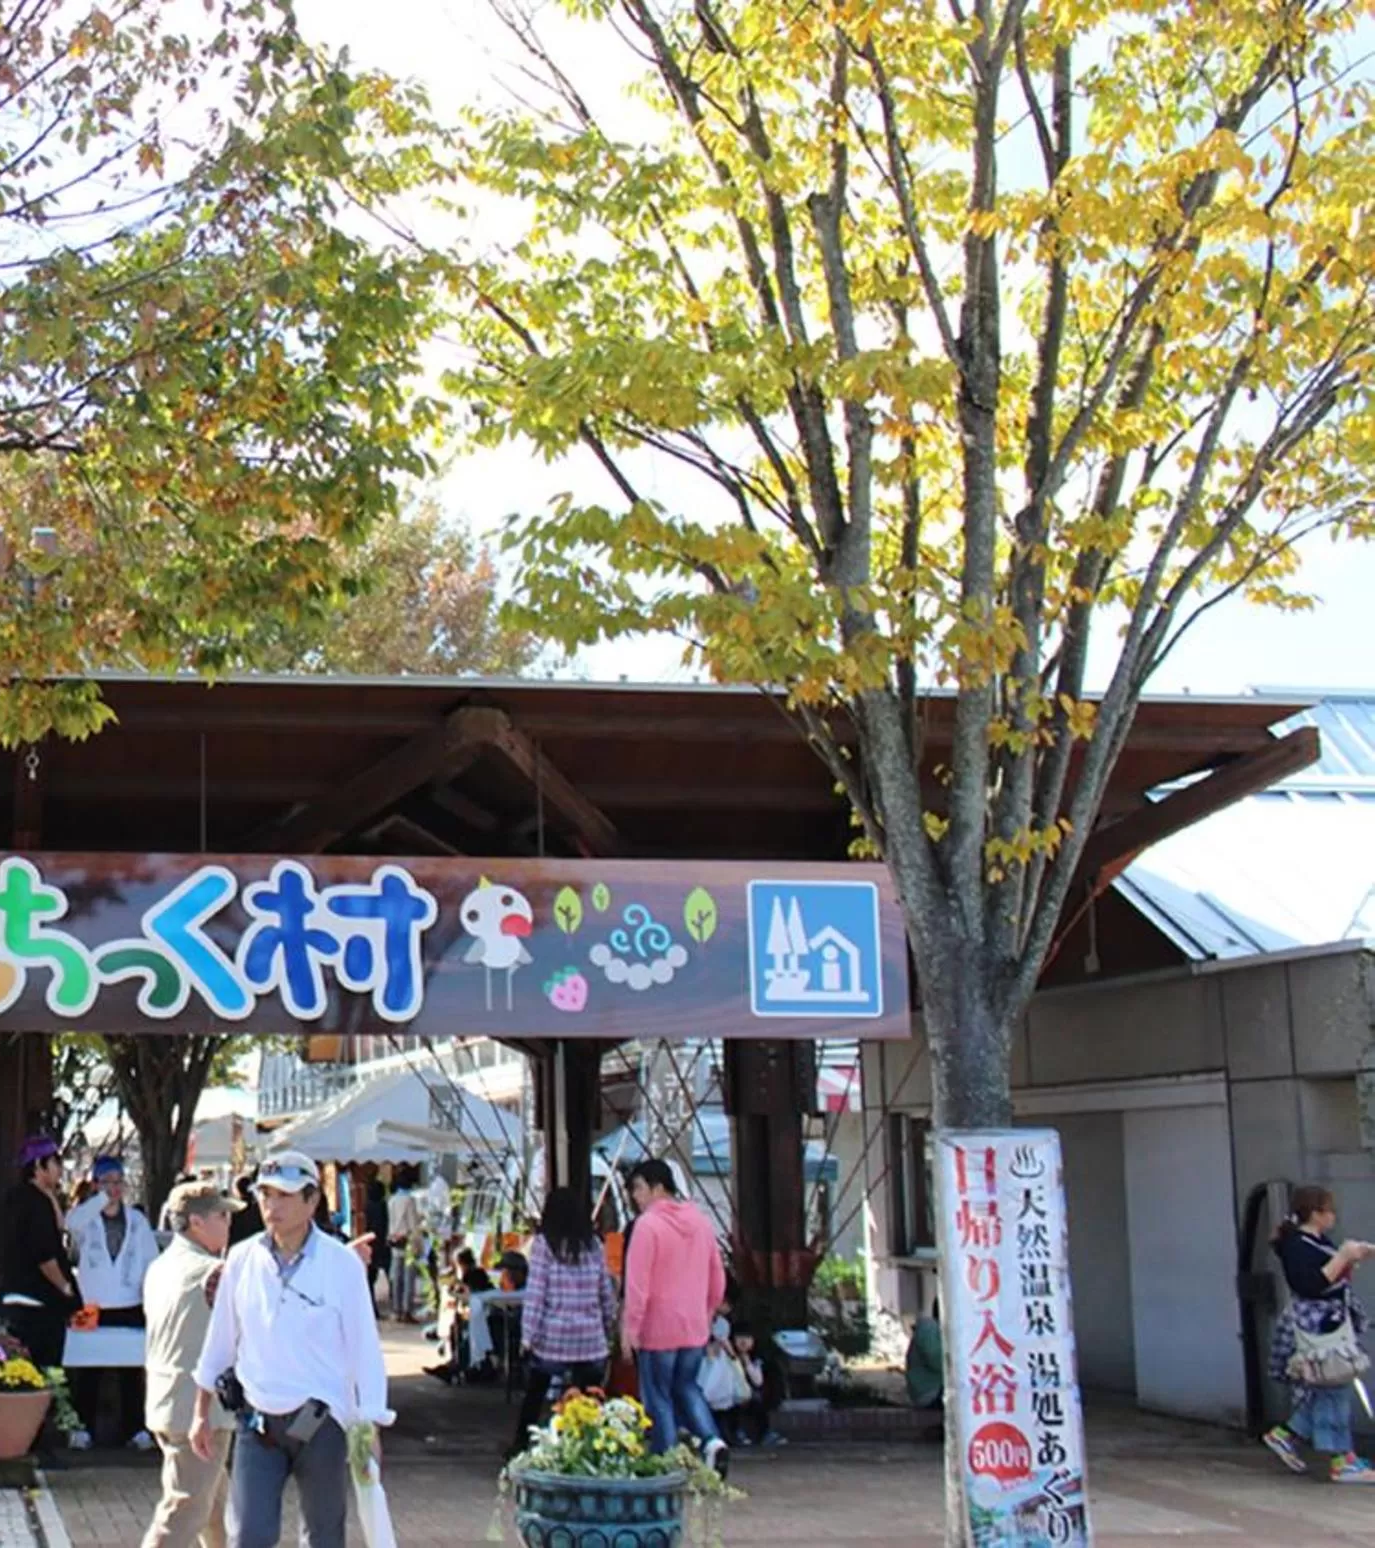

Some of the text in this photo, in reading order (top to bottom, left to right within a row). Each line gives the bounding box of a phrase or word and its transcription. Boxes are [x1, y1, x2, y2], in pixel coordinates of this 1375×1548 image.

[953, 1145, 1019, 1416] 日帰り入浴
